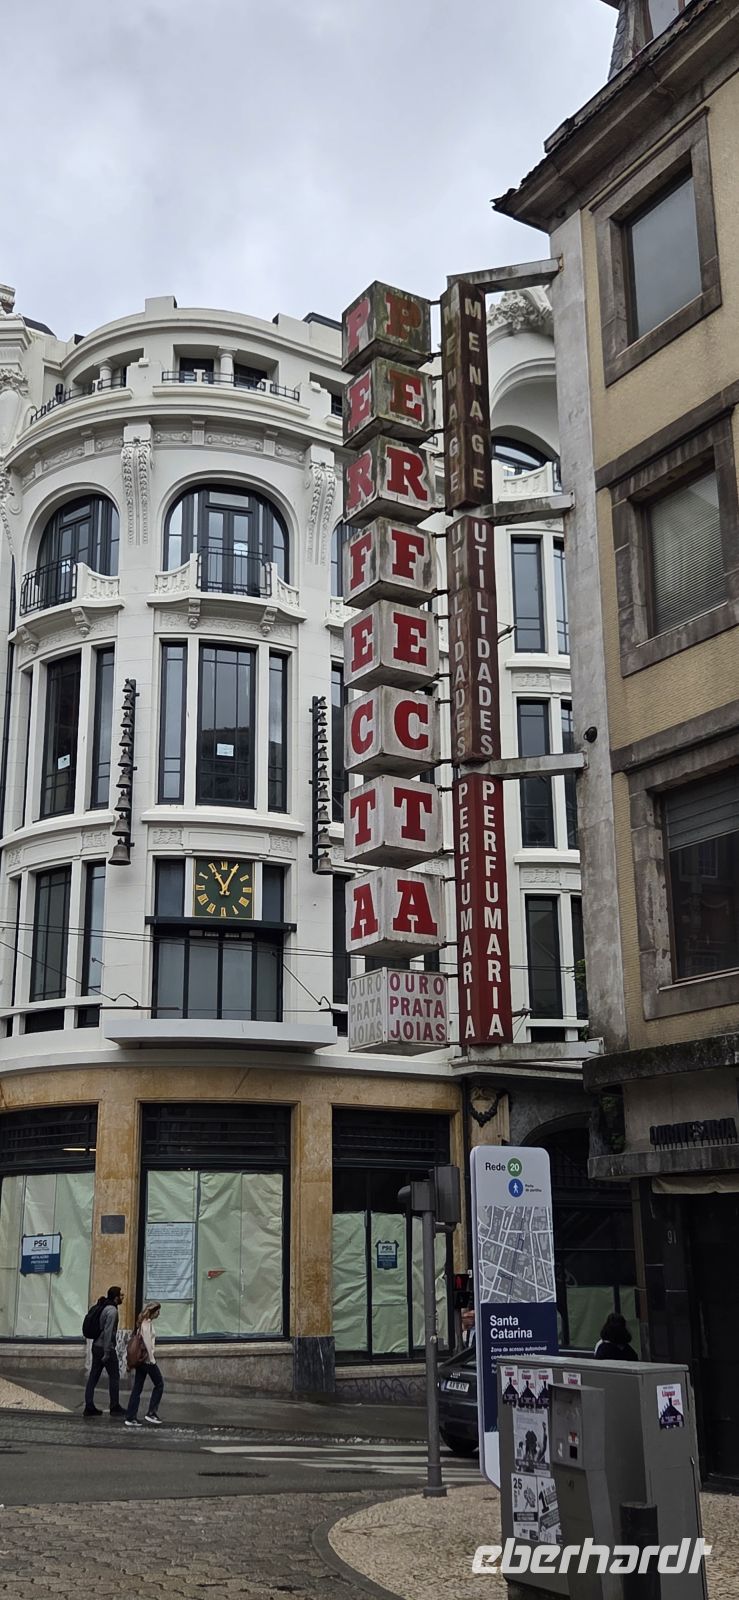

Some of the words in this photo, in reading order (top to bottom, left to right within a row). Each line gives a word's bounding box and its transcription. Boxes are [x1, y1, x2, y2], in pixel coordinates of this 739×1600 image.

[444, 304, 460, 493] MENAGE
[464, 297, 486, 490] MENAGE
[346, 296, 379, 941] PERFECTA
[386, 292, 438, 937] PERFECTA
[451, 523, 466, 758] UTILIDADES
[474, 521, 493, 756] UTILIDADES
[458, 782, 476, 1040] PERFUMARIA
[482, 779, 504, 1038] PERFUMARIA
[350, 974, 382, 1000] OURO
[389, 972, 445, 996] OURO
[350, 996, 382, 1022] PRATA
[389, 995, 445, 1019] PRATA
[350, 1020, 383, 1046] JOIAS
[389, 1019, 446, 1042] JOIAS
[485, 1161, 506, 1172] Rede
[510, 1163, 519, 1172] 20
[490, 1315, 519, 1326] Santa
[490, 1327, 533, 1339] Catarina
[513, 1477, 523, 1490] 25
